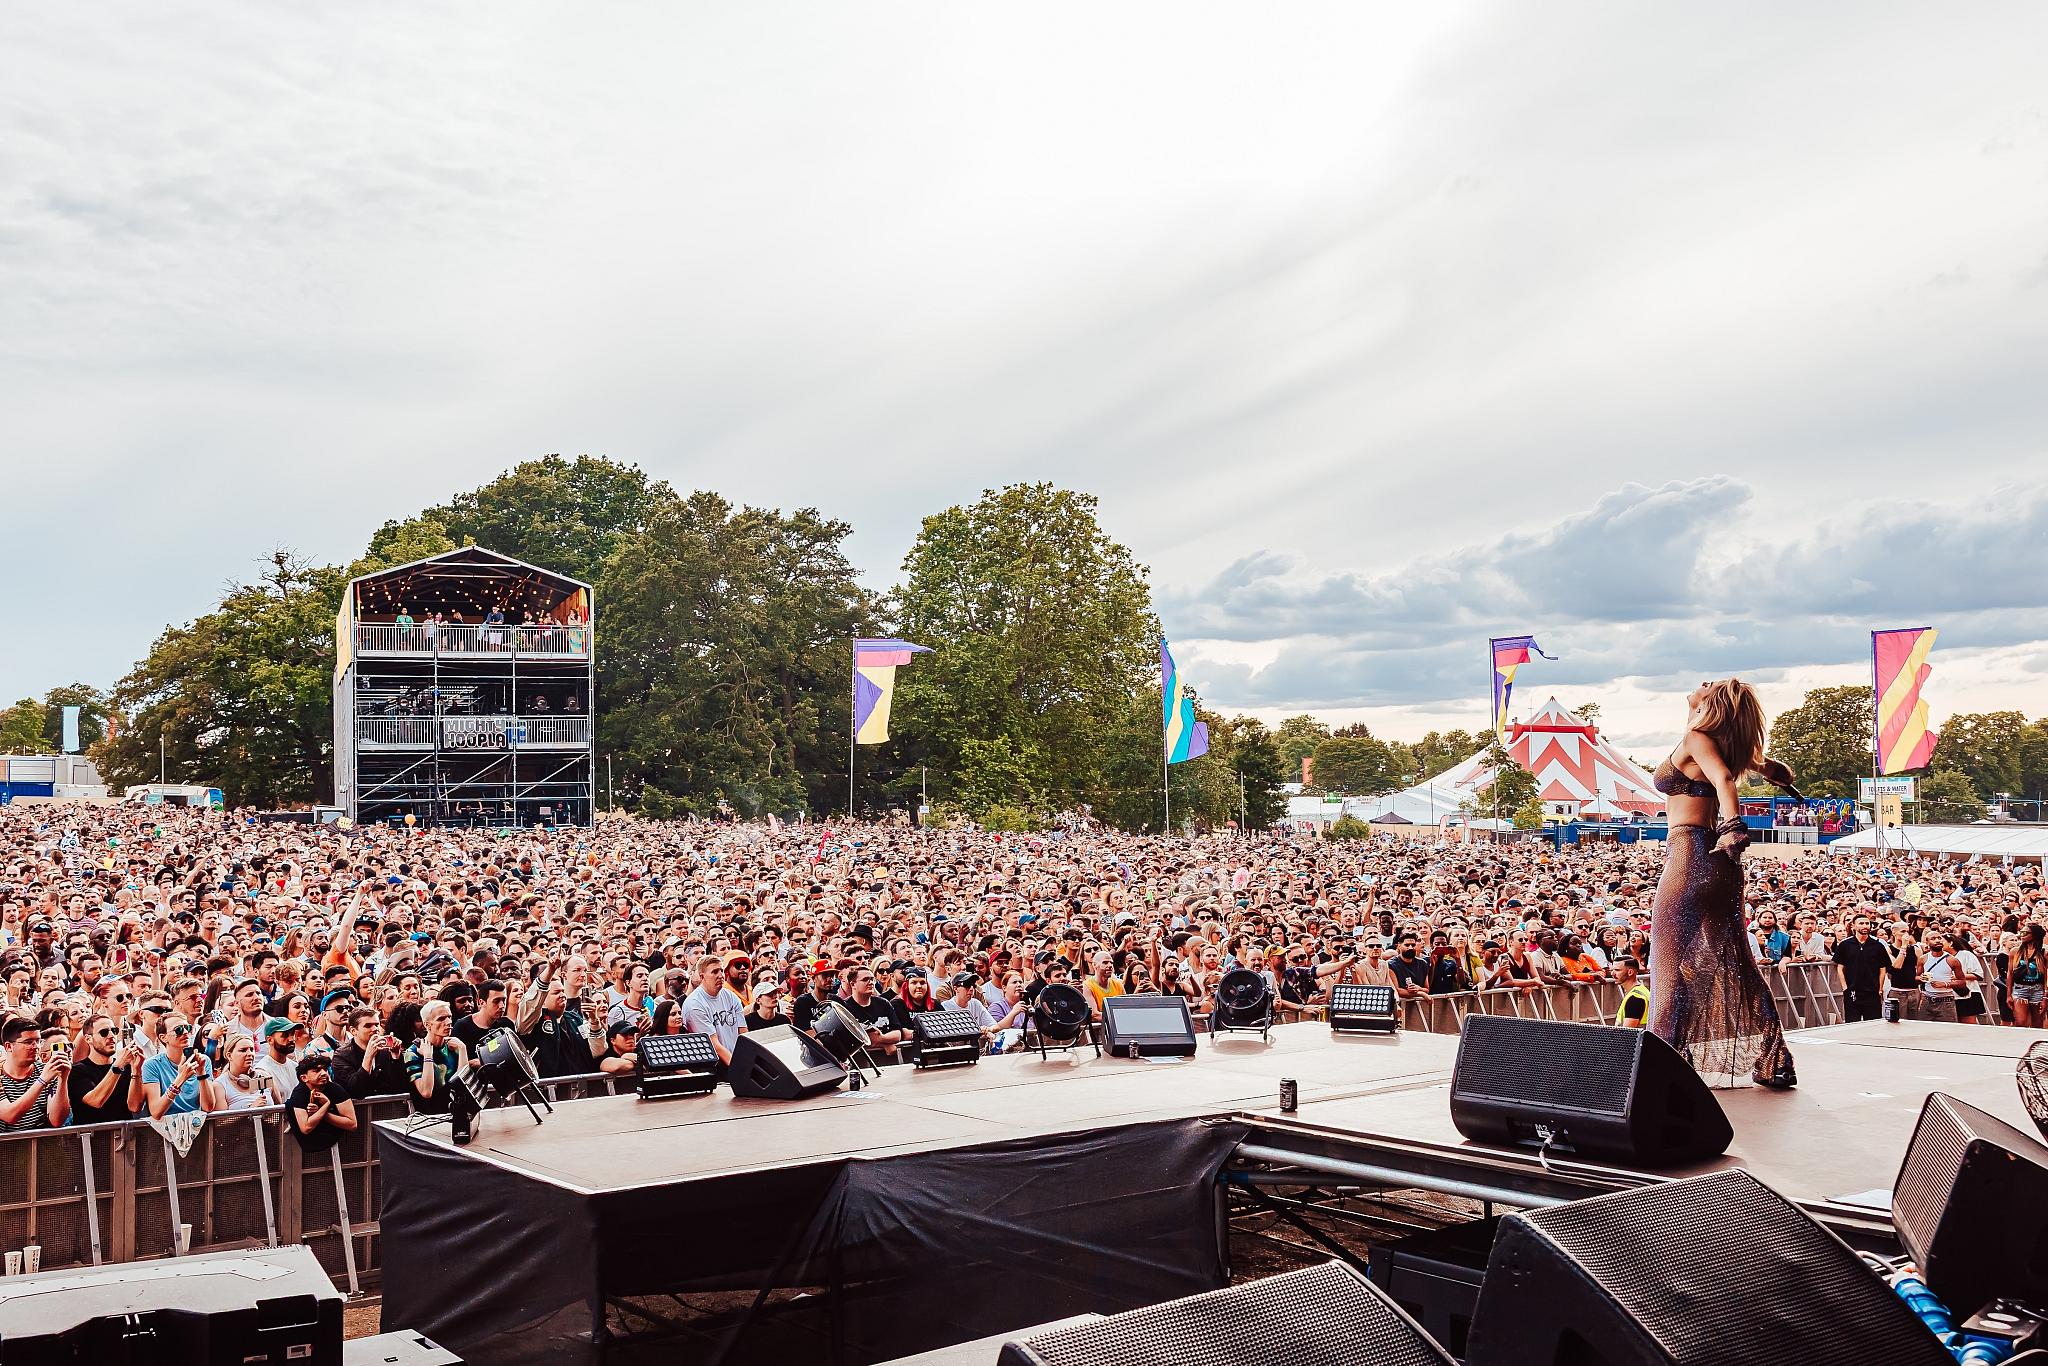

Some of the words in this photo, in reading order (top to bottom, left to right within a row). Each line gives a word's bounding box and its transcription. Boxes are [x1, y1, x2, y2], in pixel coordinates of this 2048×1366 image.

[444, 718, 506, 733] MIGHTY
[444, 732, 506, 748] HOOPLA
[1881, 805, 1894, 815] BAR
